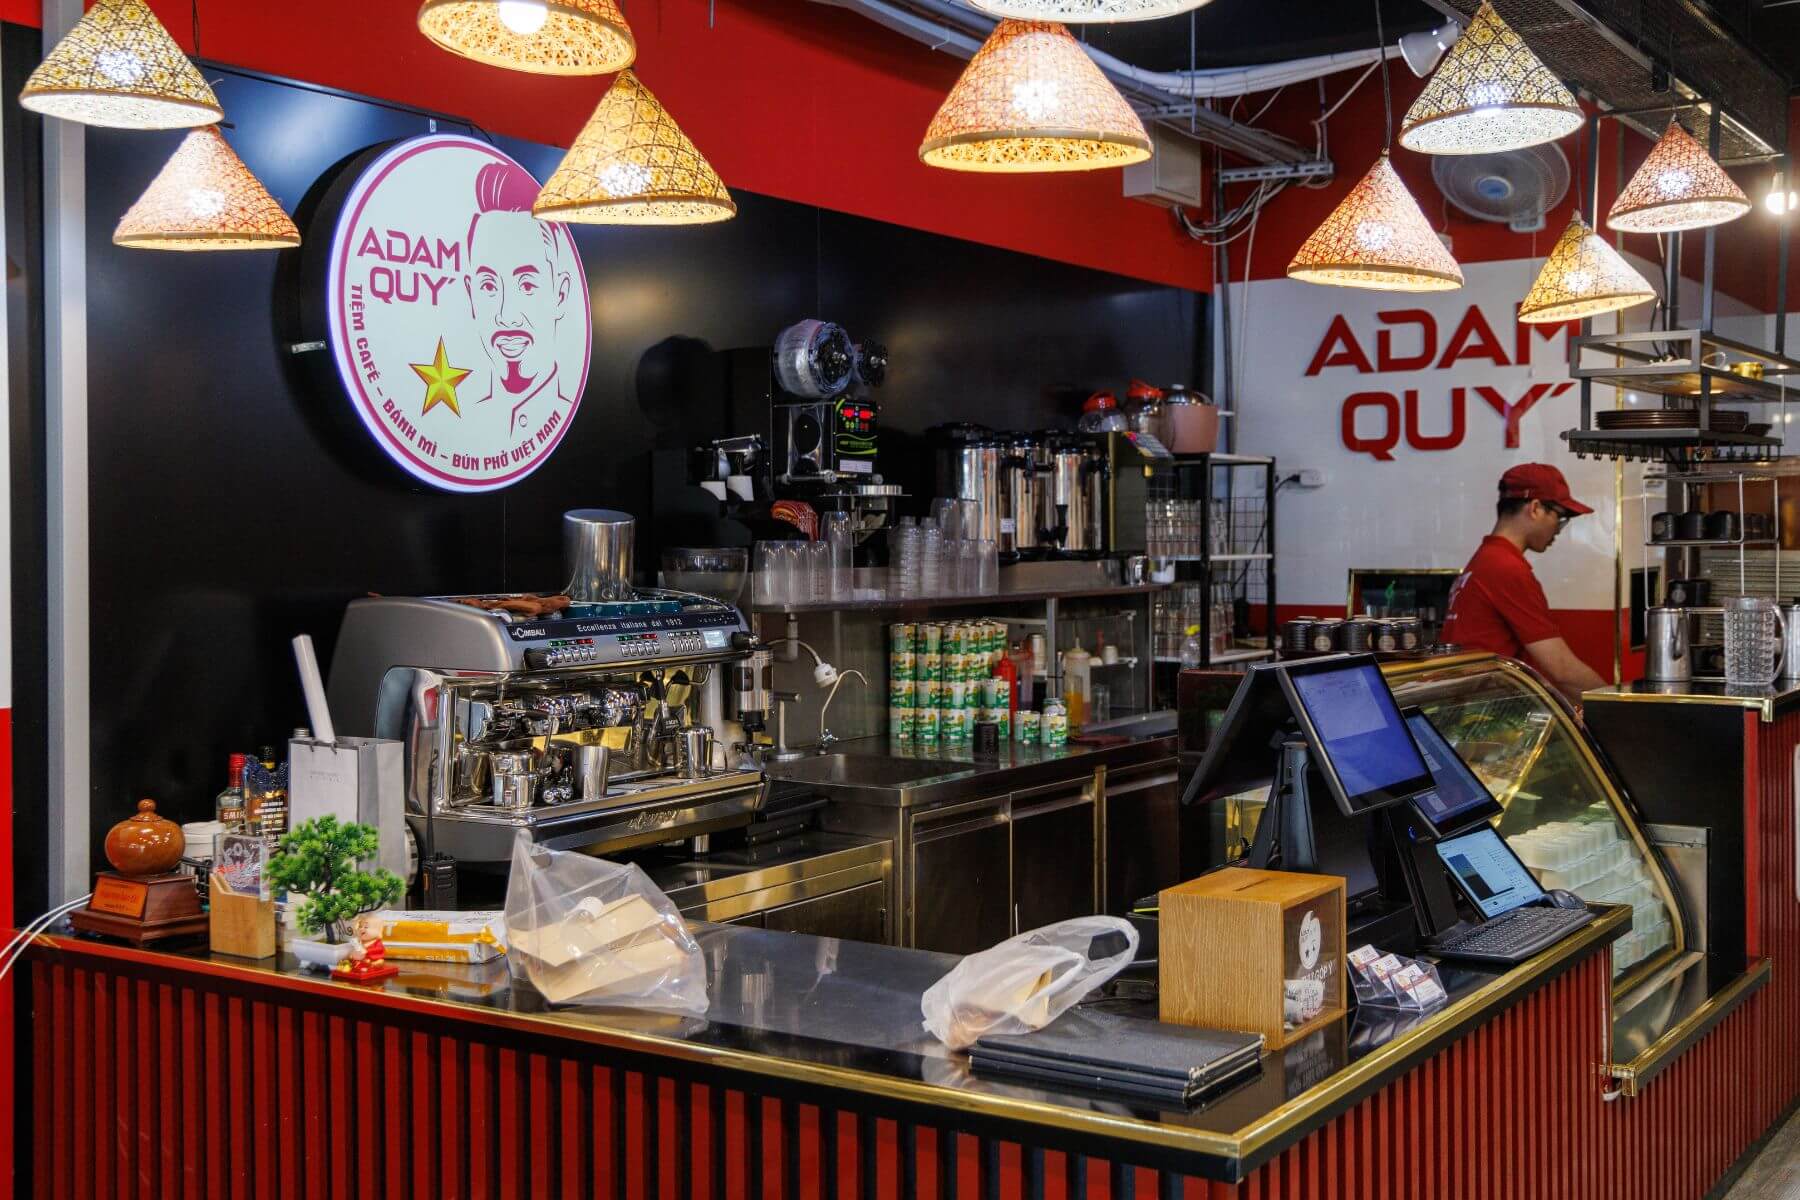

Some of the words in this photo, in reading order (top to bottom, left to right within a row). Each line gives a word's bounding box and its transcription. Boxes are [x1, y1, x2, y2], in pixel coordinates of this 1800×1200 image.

[357, 227, 460, 272] ADAM
[1304, 301, 1581, 377] ADAM
[356, 337, 381, 383] CAFÉ
[383, 398, 417, 441] BÁNH
[452, 453, 479, 470] BÚN
[484, 450, 509, 471] PHỞ
[511, 438, 536, 462] VIỆT
[536, 410, 561, 443] NAM
